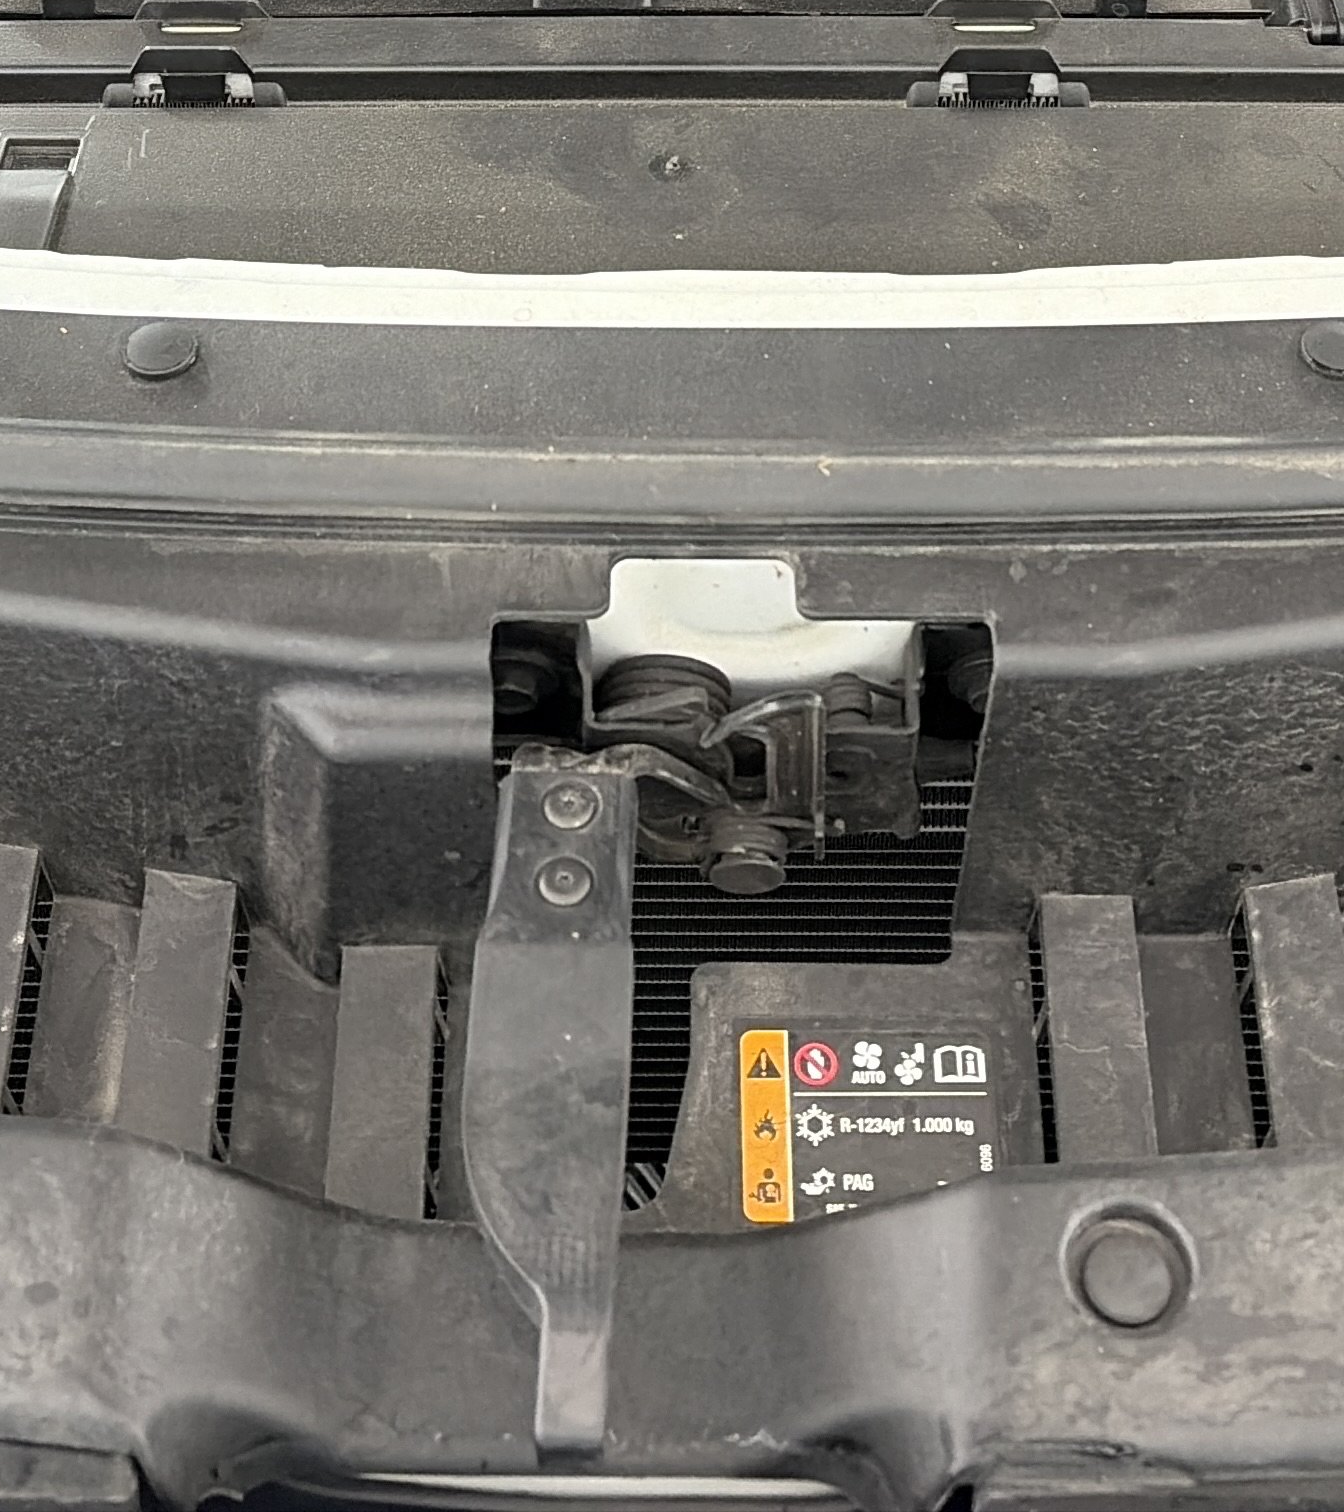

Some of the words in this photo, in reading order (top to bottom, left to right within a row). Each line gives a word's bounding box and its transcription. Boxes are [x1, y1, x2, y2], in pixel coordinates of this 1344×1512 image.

[851, 1071, 886, 1084] AUTO
[840, 1117, 905, 1136] R-1234yf
[912, 1117, 953, 1133] 1.000
[955, 1117, 974, 1135] kg
[843, 1174, 874, 1191] PAG
